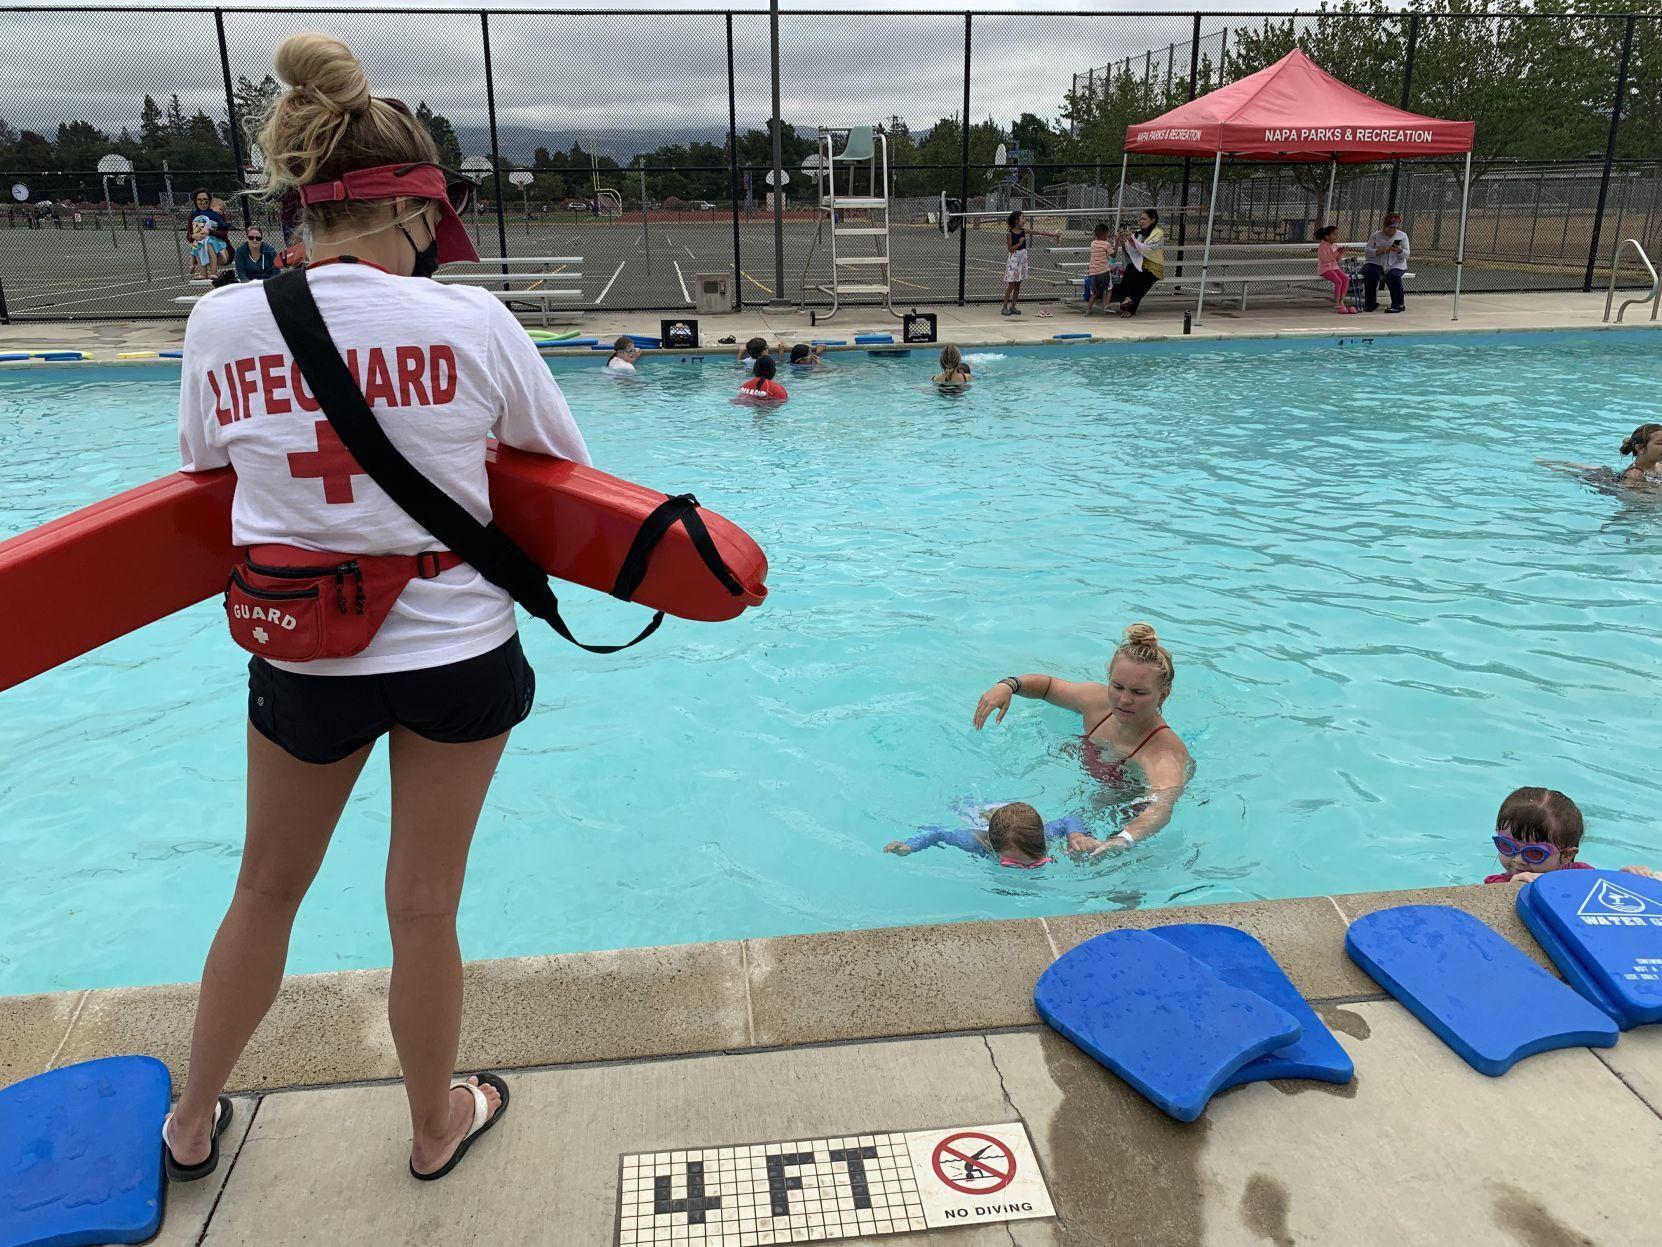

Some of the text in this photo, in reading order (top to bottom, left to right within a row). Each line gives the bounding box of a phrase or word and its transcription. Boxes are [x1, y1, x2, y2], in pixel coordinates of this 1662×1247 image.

[1265, 128, 1432, 142] NAPA PARKS & RECREATION
[207, 344, 457, 426] LIFEGARD
[233, 604, 297, 630] GUARD
[1579, 916, 1648, 926] WATER
[654, 1146, 878, 1225] 4 FT
[944, 1202, 1033, 1219] NO DIVING
